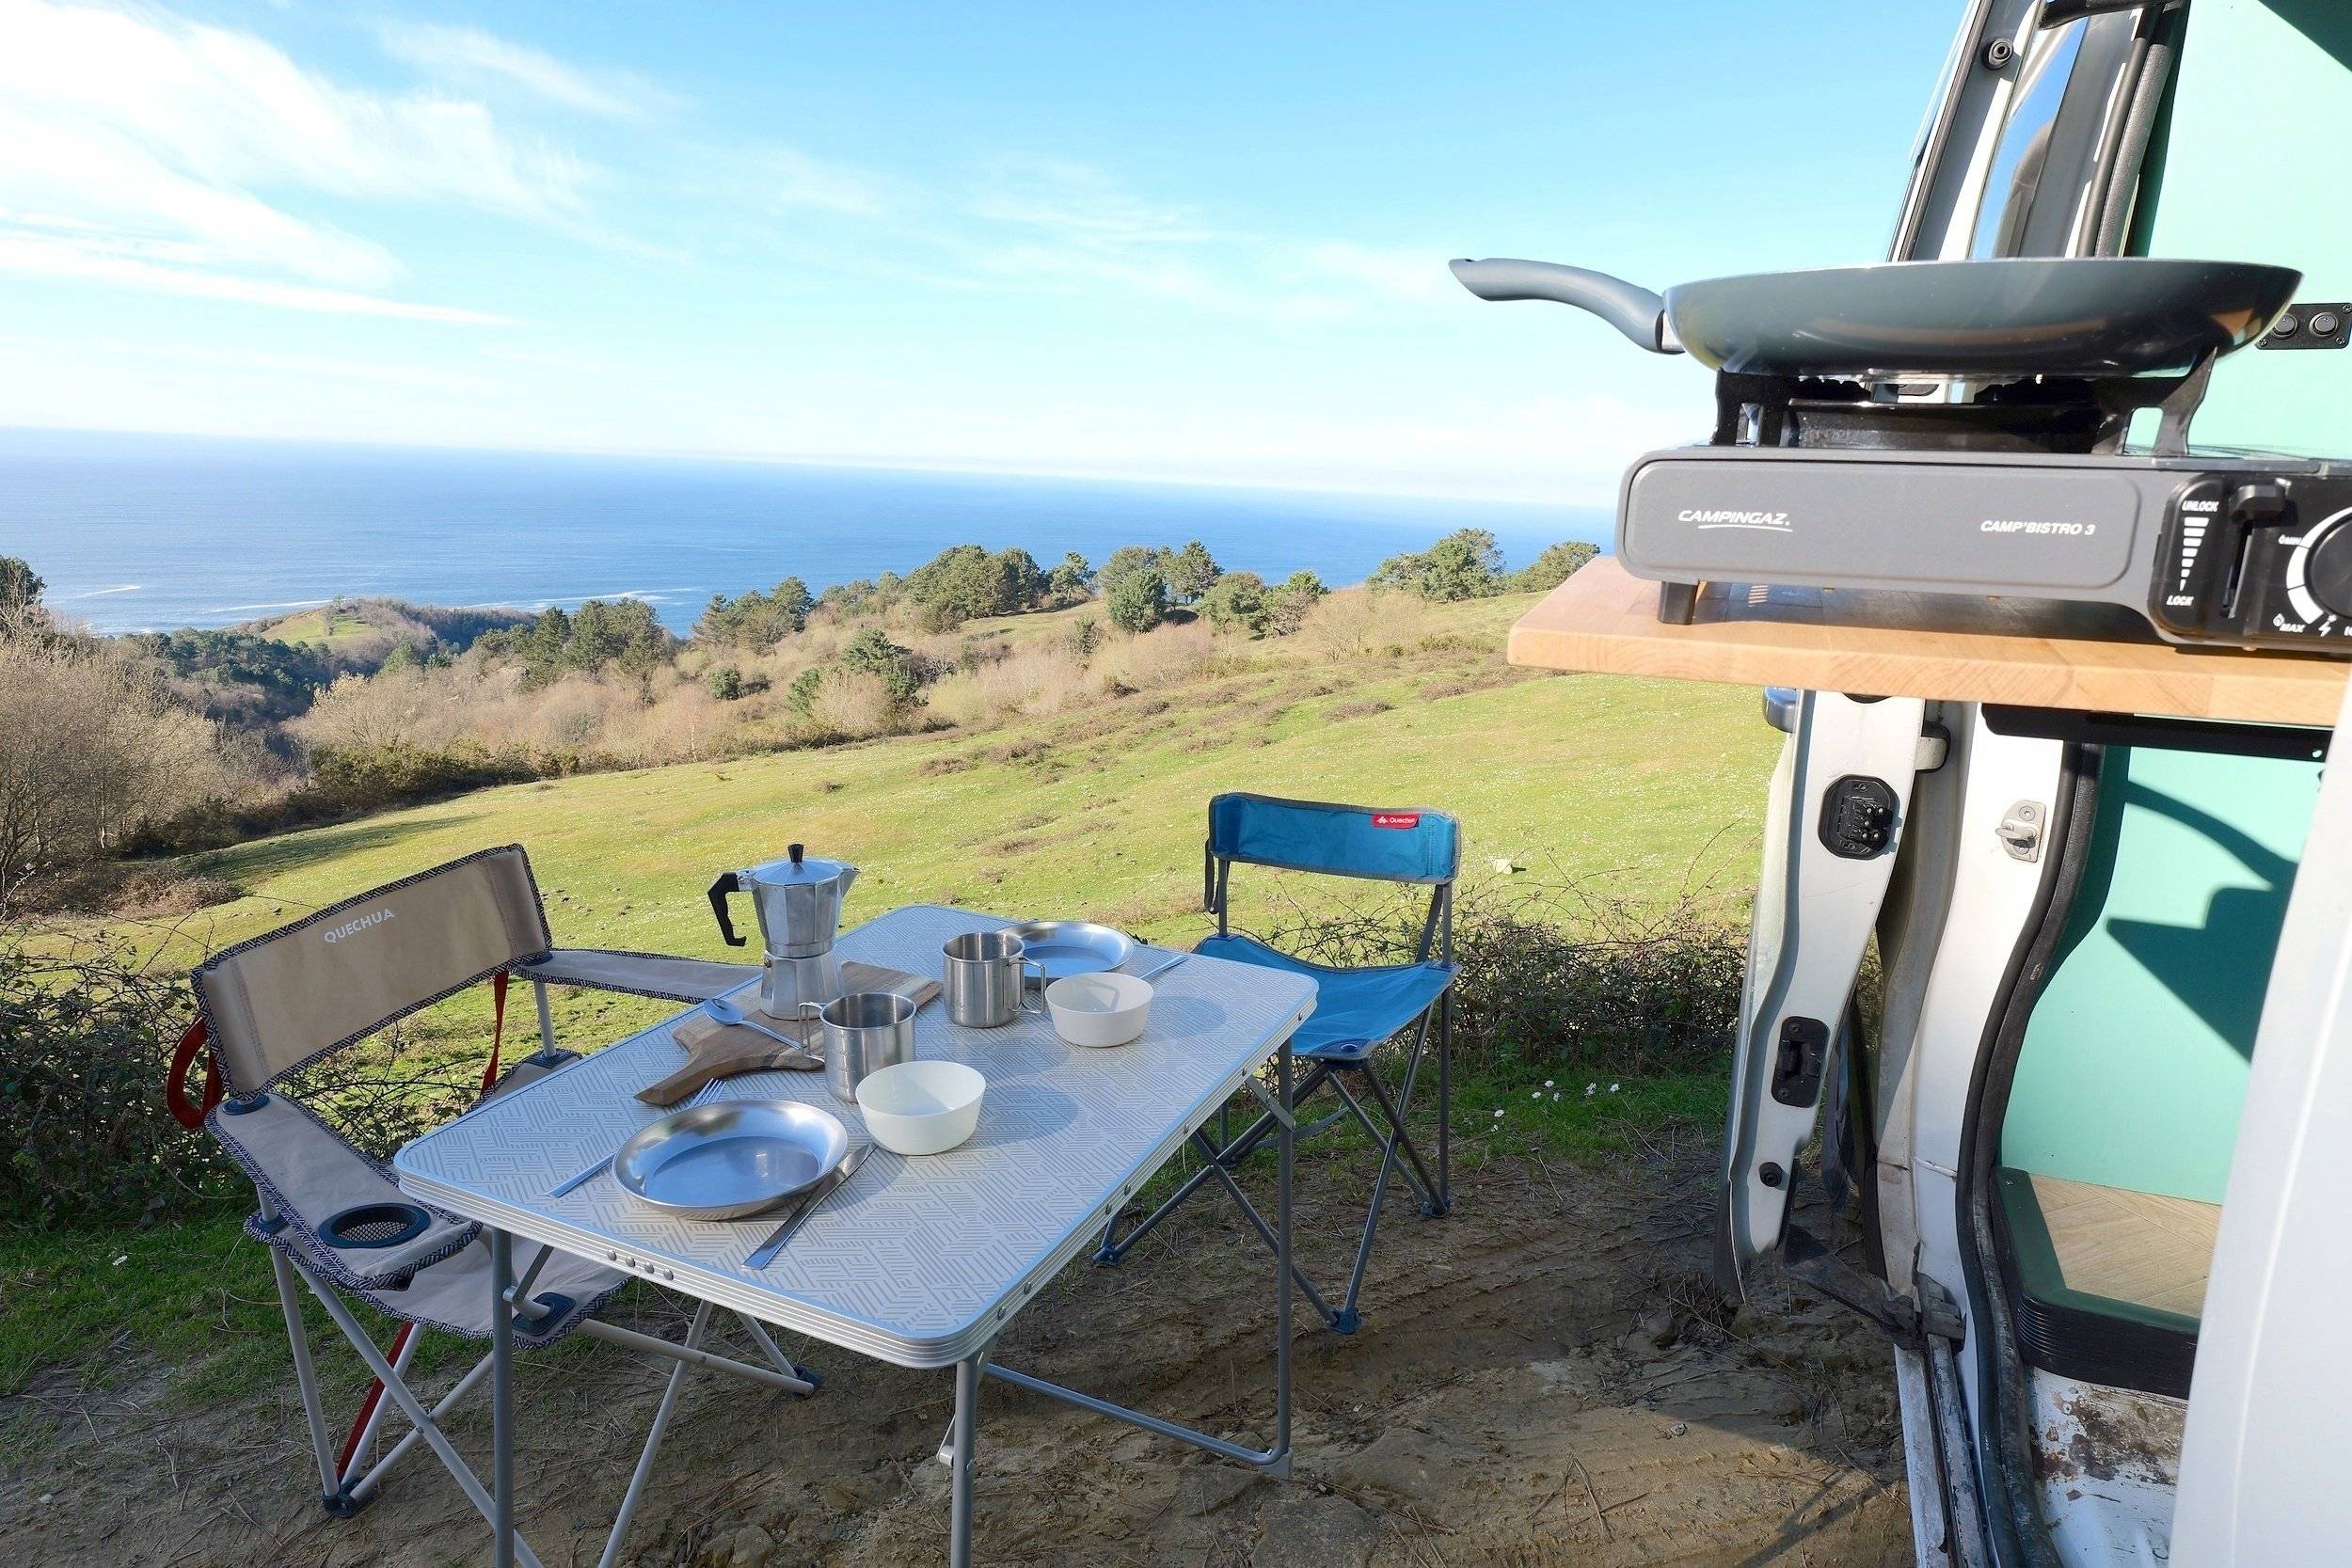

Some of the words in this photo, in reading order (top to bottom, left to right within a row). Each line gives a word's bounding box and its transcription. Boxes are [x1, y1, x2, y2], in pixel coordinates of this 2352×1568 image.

[2181, 499, 2220, 513] UNLOCK
[1980, 520, 2083, 535] CAMP'BISTRO
[2084, 524, 2096, 535] 3
[2166, 594, 2195, 607] LOCK
[2280, 623, 2306, 633] MAX
[324, 908, 396, 943] QUECHUA
